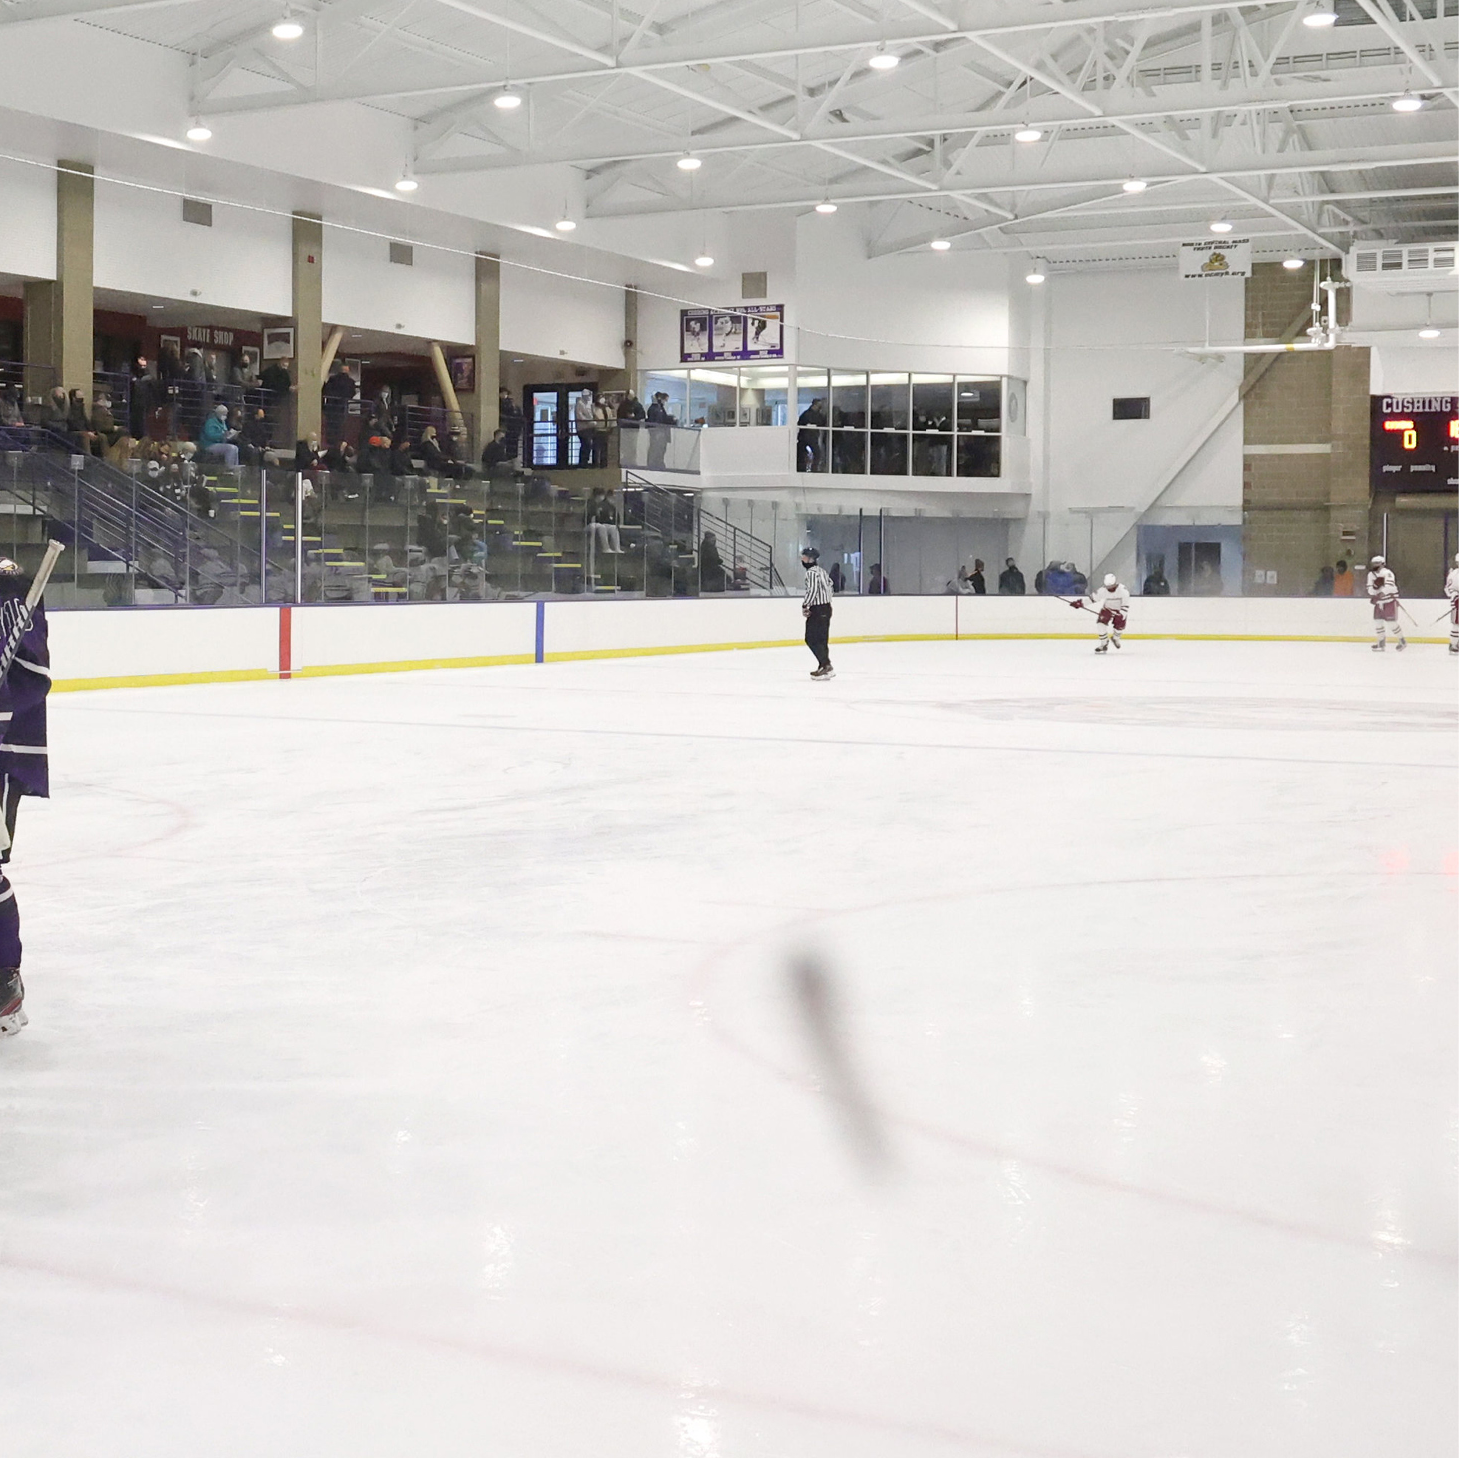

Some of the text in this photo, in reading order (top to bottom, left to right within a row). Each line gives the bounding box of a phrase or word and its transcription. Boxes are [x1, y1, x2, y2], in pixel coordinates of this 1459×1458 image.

[187, 326, 234, 346] SKATE SHOP
[1382, 397, 1452, 413] CUSHING
[1403, 429, 1417, 449] 0
